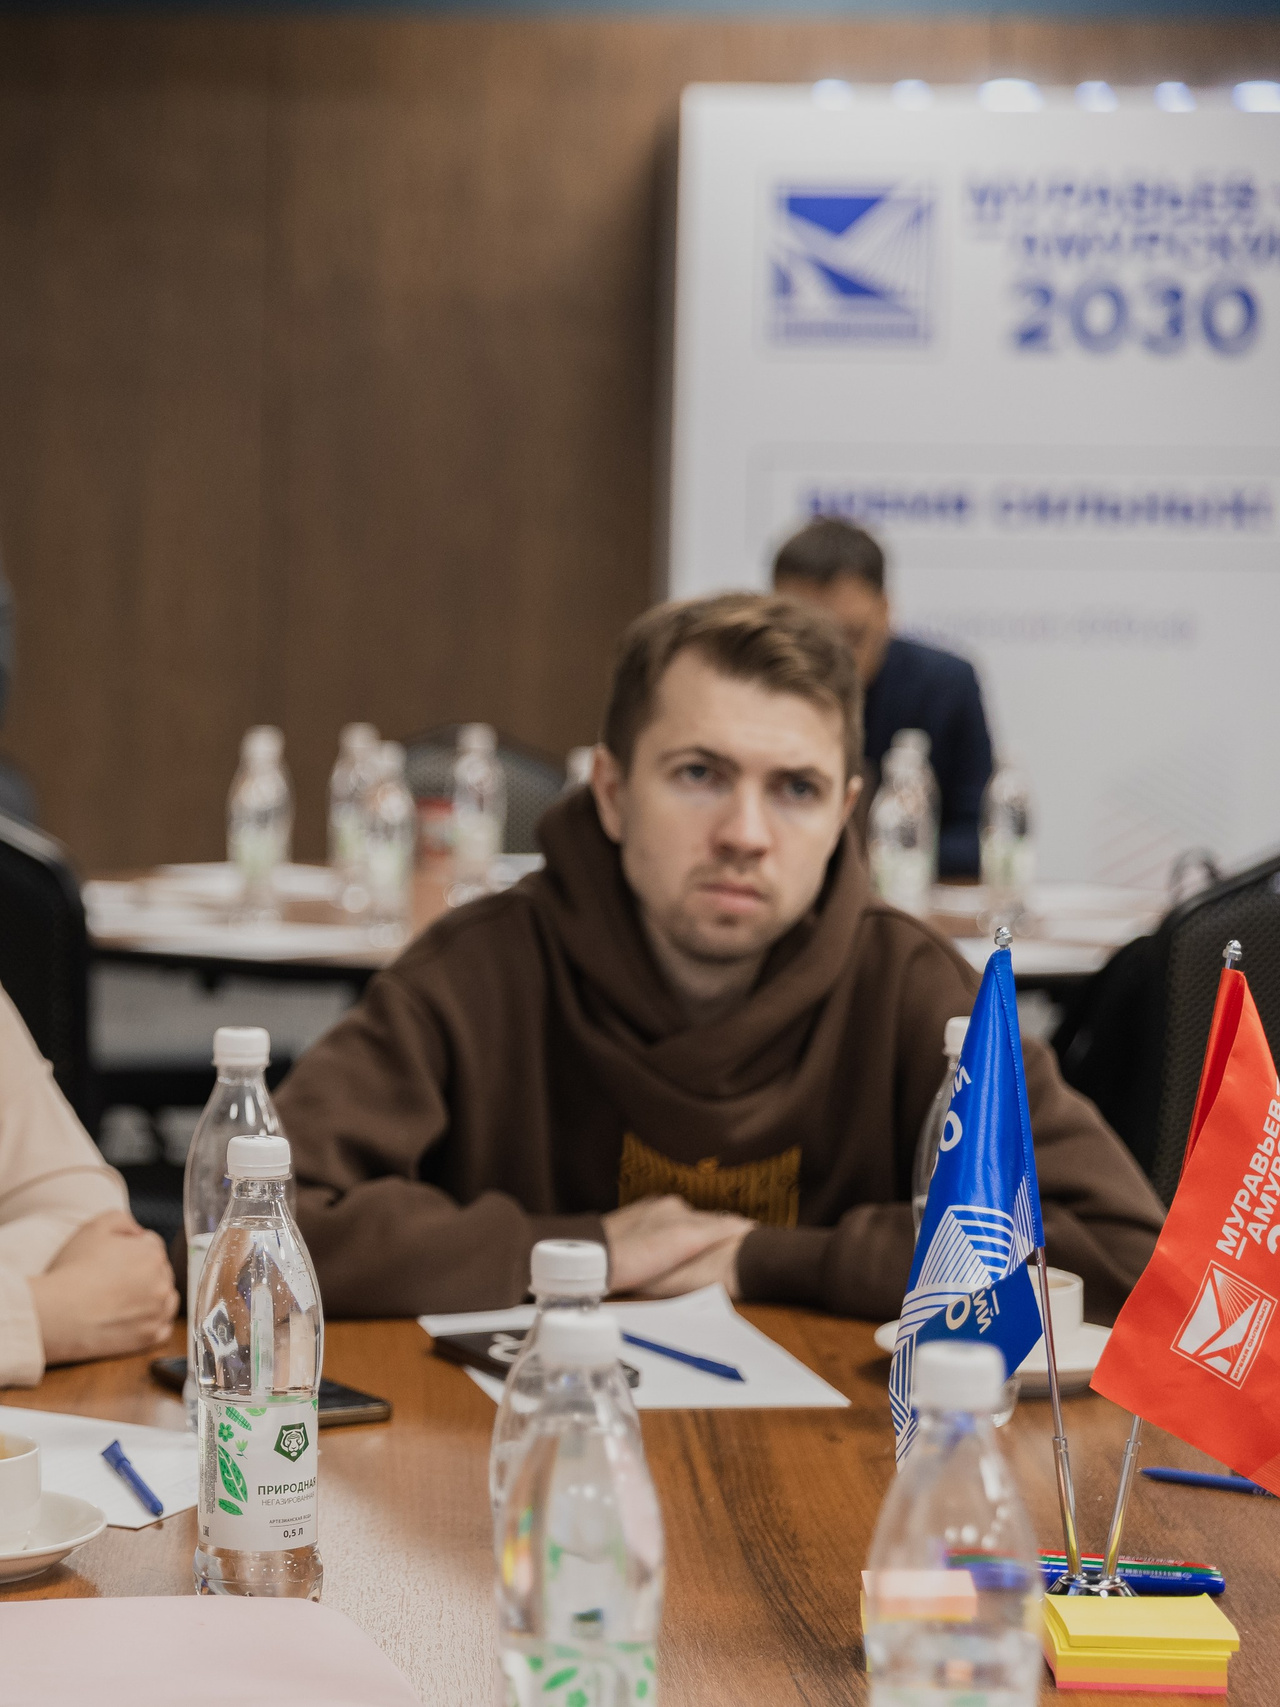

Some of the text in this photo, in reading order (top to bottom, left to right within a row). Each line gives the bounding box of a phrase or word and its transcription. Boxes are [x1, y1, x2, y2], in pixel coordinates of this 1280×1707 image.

[1012, 278, 1262, 356] 2030
[1215, 1098, 1280, 1257] МУРАВЬЕВ
[257, 1476, 316, 1495] ПРИРОДНАЯ
[283, 1528, 297, 1539] 0,5
